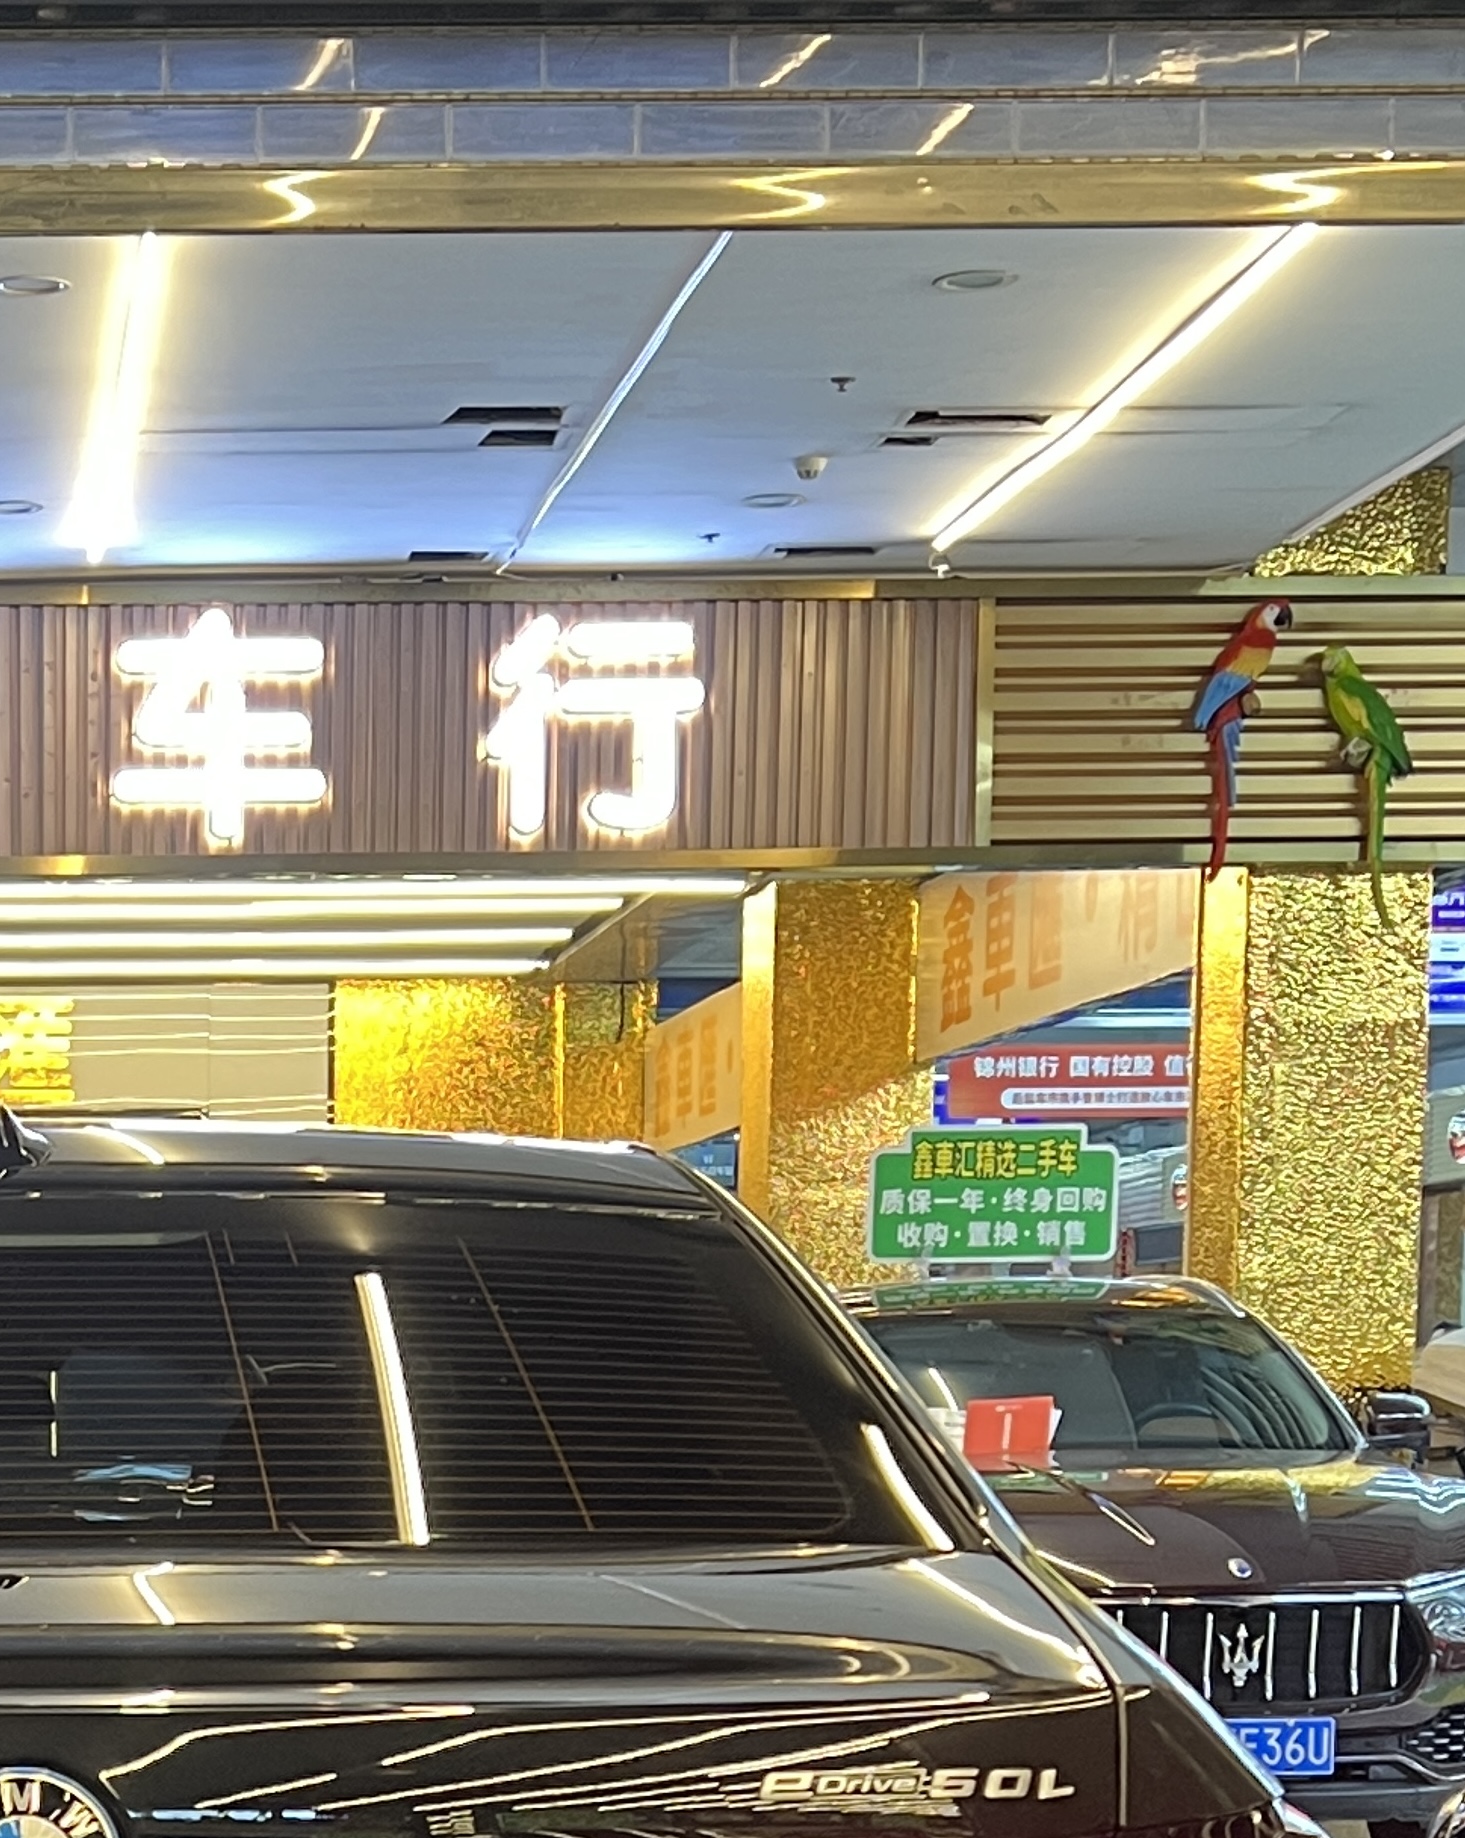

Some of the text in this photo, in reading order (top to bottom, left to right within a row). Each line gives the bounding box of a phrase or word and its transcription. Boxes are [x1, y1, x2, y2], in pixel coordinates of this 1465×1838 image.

[879, 1187, 1107, 1215] 质保一年·终身回购
[897, 1220, 1086, 1248] 收购·置换·销售
